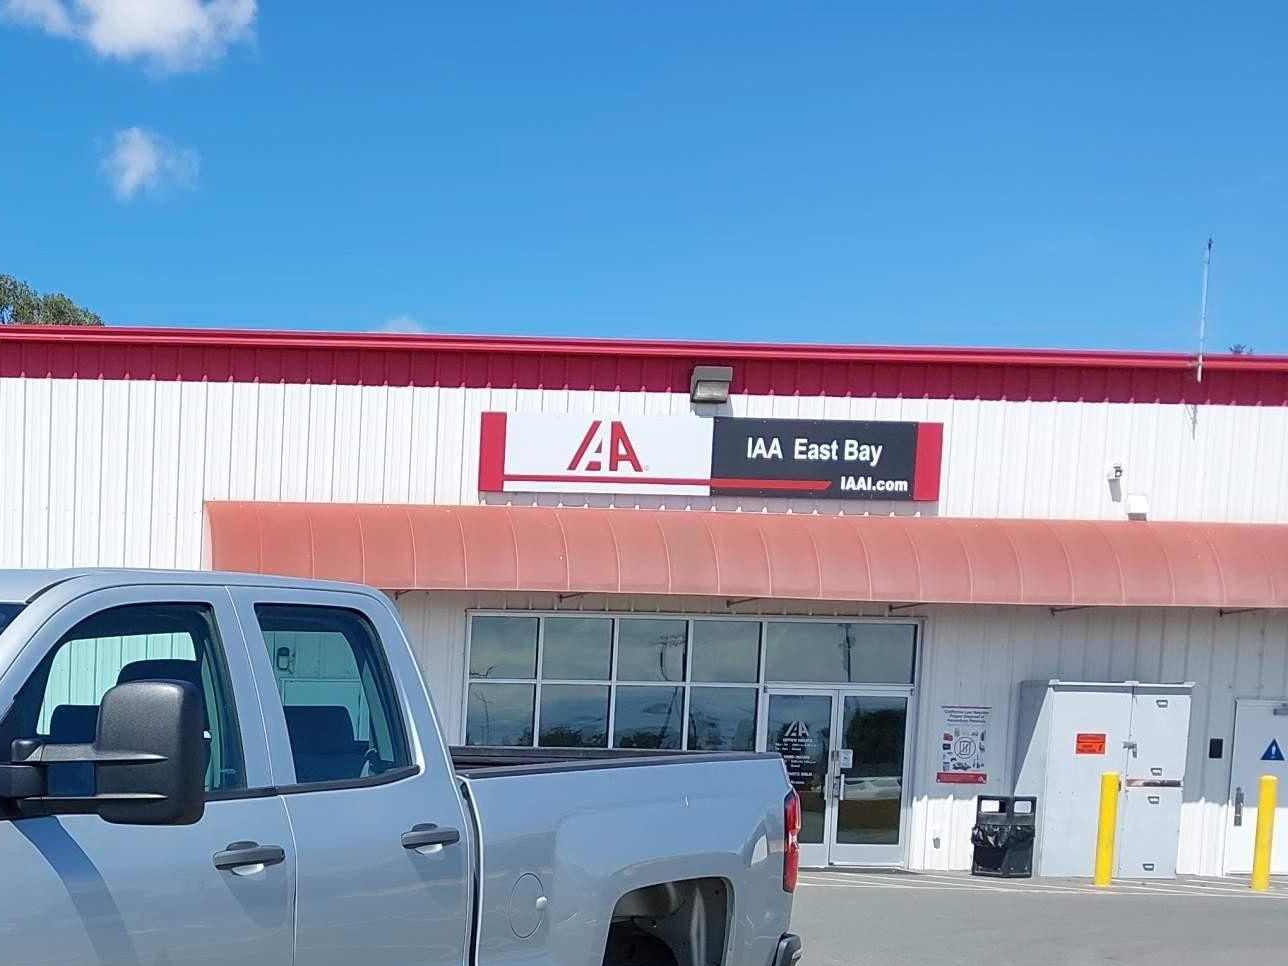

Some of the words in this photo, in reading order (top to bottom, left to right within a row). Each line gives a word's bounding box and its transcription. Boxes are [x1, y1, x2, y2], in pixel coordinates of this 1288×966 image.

[746, 437, 784, 459] IAA
[793, 438, 839, 461] East
[843, 439, 883, 467] Bay
